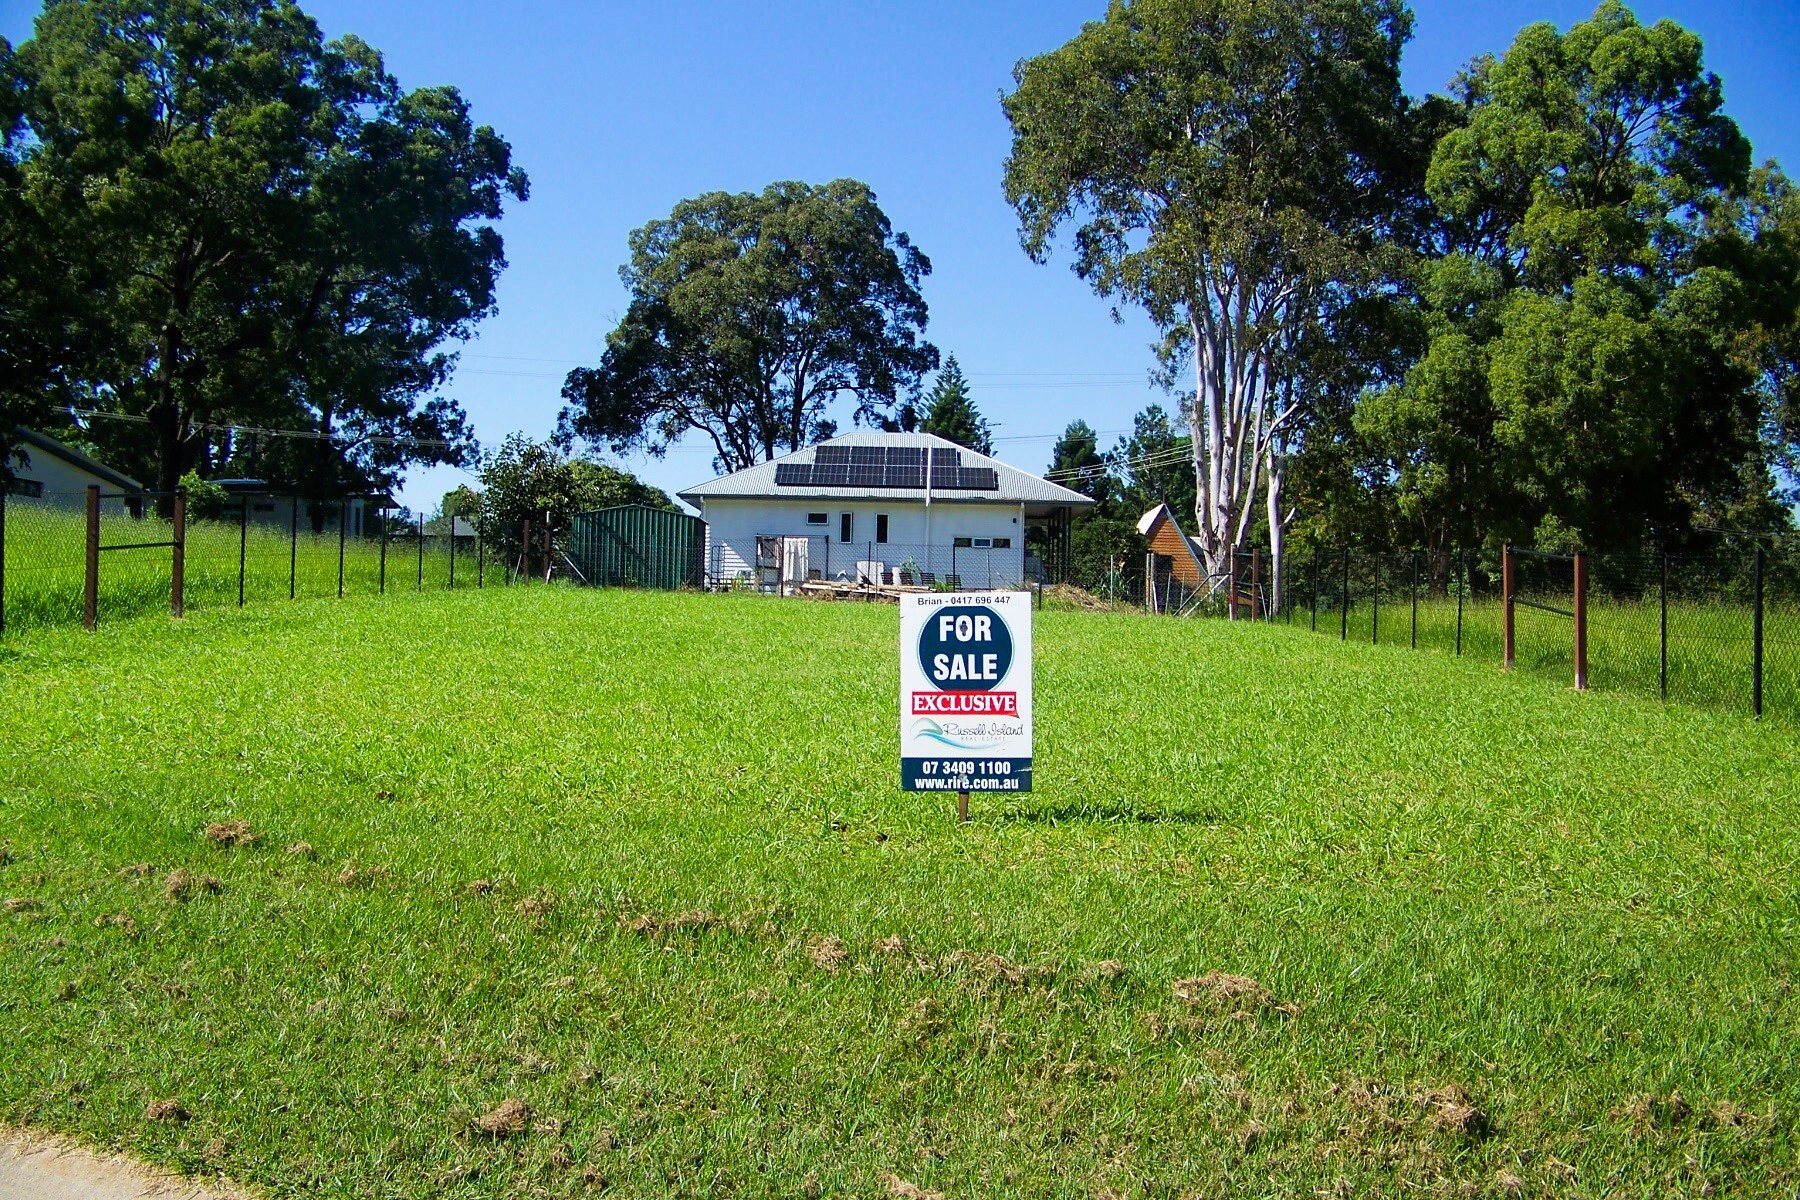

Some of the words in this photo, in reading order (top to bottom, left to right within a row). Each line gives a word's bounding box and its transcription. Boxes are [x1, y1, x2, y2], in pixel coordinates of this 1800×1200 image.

[918, 597, 942, 606] Brian
[951, 596, 973, 604] 0417
[975, 596, 992, 604] 696
[994, 596, 1011, 604] 447
[939, 615, 992, 642] FOR
[933, 653, 998, 681] SALE
[913, 694, 1015, 712] EXCLUSIVE
[942, 722, 986, 736] Russell
[987, 722, 1024, 736] Island
[922, 761, 939, 774] 07
[942, 761, 974, 774] 3409
[979, 761, 1011, 774] 1100
